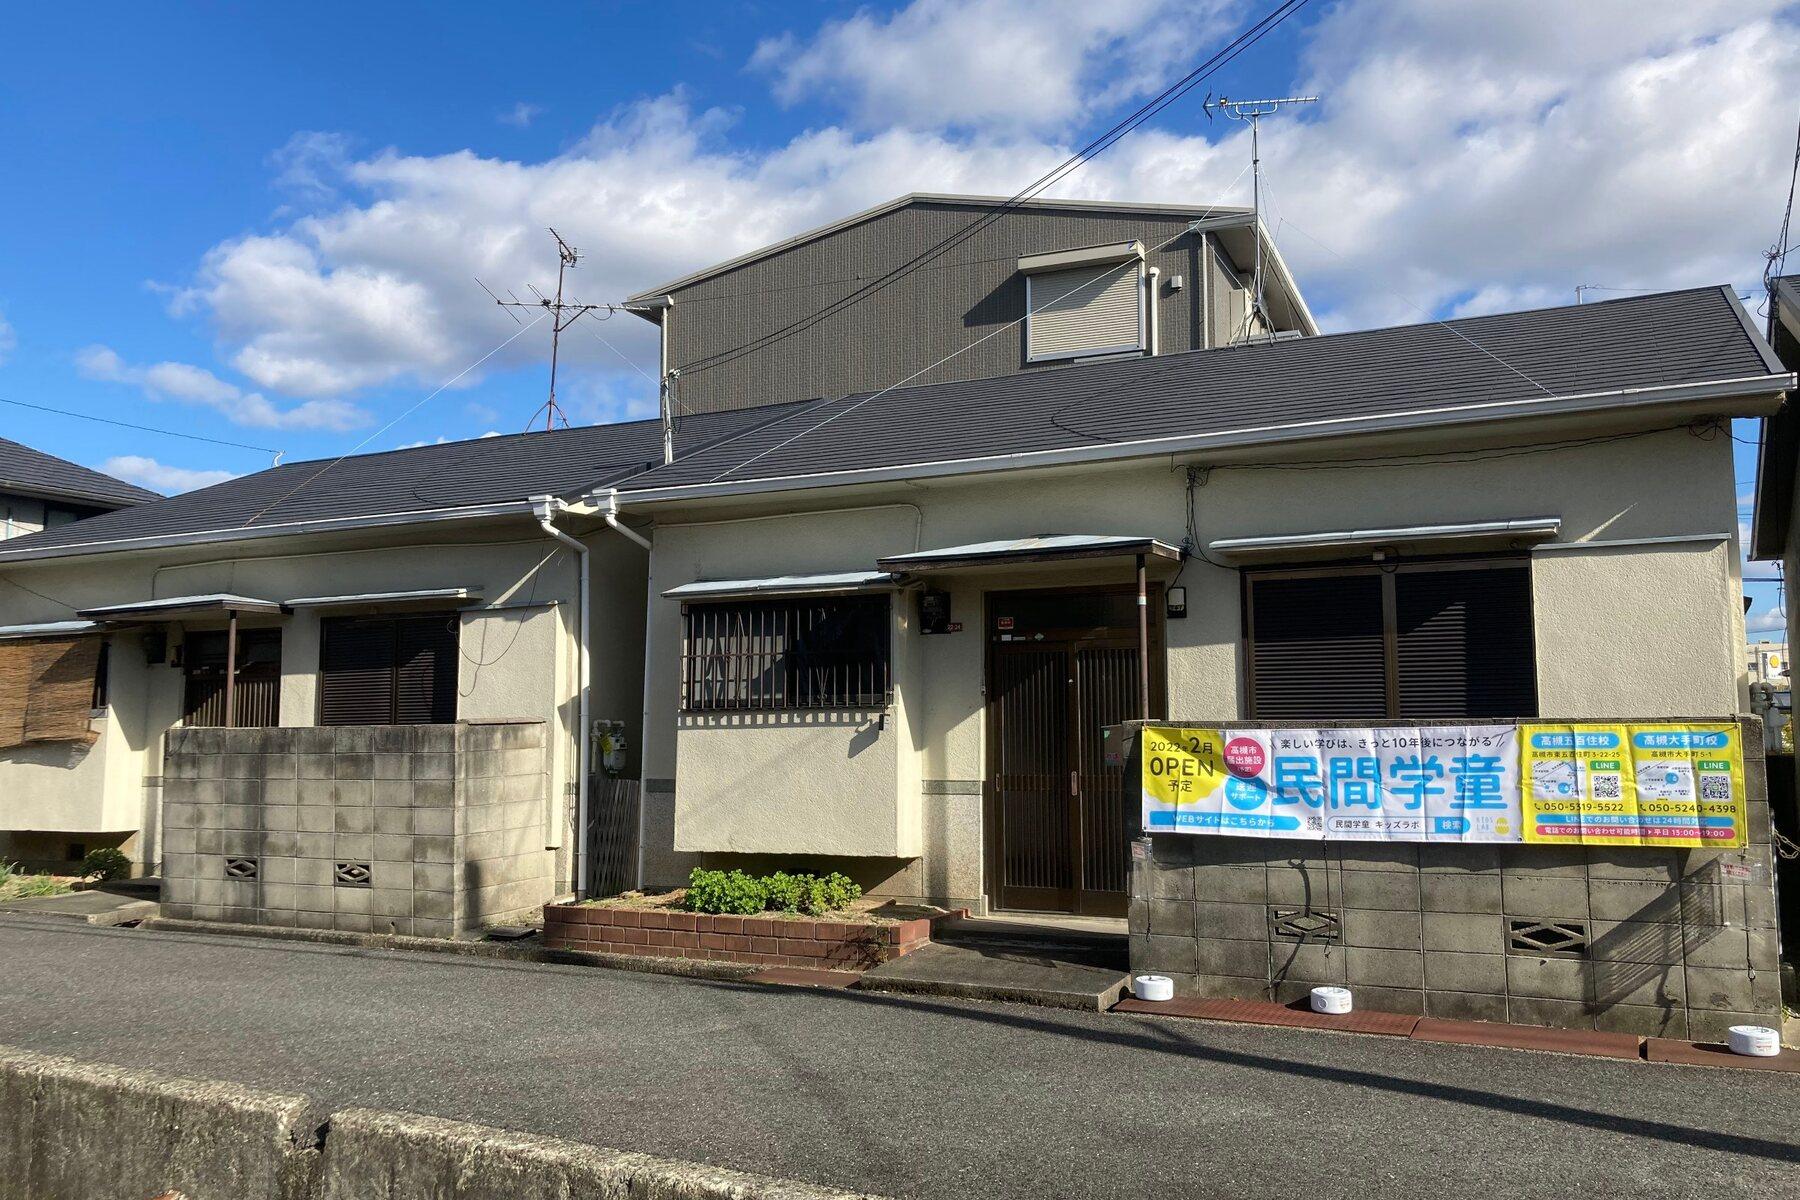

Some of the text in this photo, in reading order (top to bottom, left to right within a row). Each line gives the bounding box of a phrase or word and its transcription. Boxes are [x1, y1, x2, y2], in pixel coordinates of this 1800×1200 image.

[1541, 735, 1610, 746] 高槻五百住校
[1644, 735, 1718, 745] 高槻大手町校
[1230, 745, 1257, 755] 高槻市
[1150, 757, 1214, 777] OPEN
[1168, 780, 1192, 792] 予定
[1272, 754, 1508, 810] 民間学童
[1231, 793, 1260, 801] サポート
[1544, 803, 1624, 812] 050-5319-5522
[1649, 803, 1736, 813] 050-5240-4398
[1173, 815, 1275, 827] WEBサイトはこちらから
[1335, 819, 1420, 829] 民間学童 キッズラボ
[1442, 820, 1463, 830] 検索
